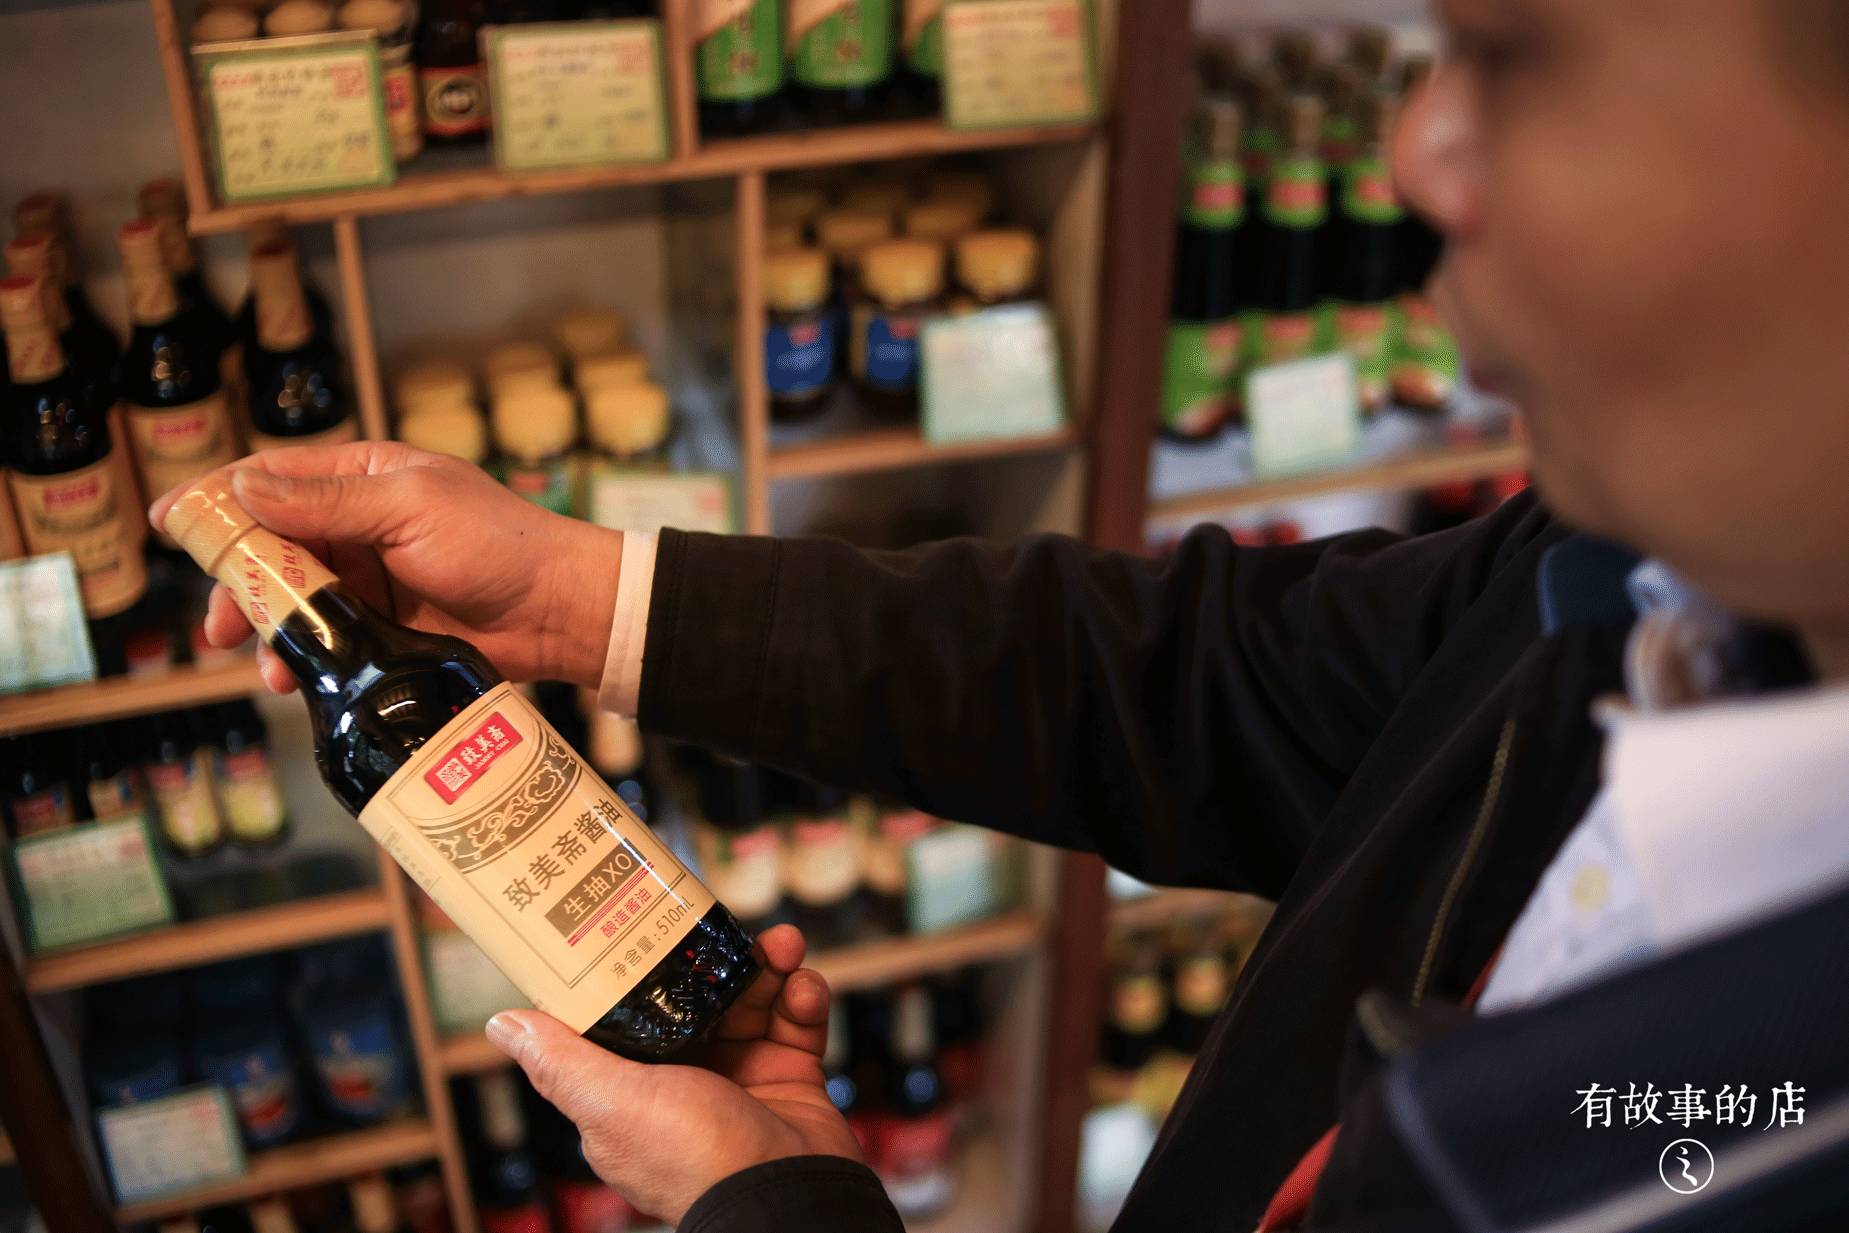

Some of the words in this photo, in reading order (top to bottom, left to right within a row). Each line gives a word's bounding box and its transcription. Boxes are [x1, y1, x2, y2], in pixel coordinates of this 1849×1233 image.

[502, 798, 623, 912] 致美斋酱油
[564, 852, 633, 921] 生抽XO
[599, 886, 653, 939] 酿造酱油
